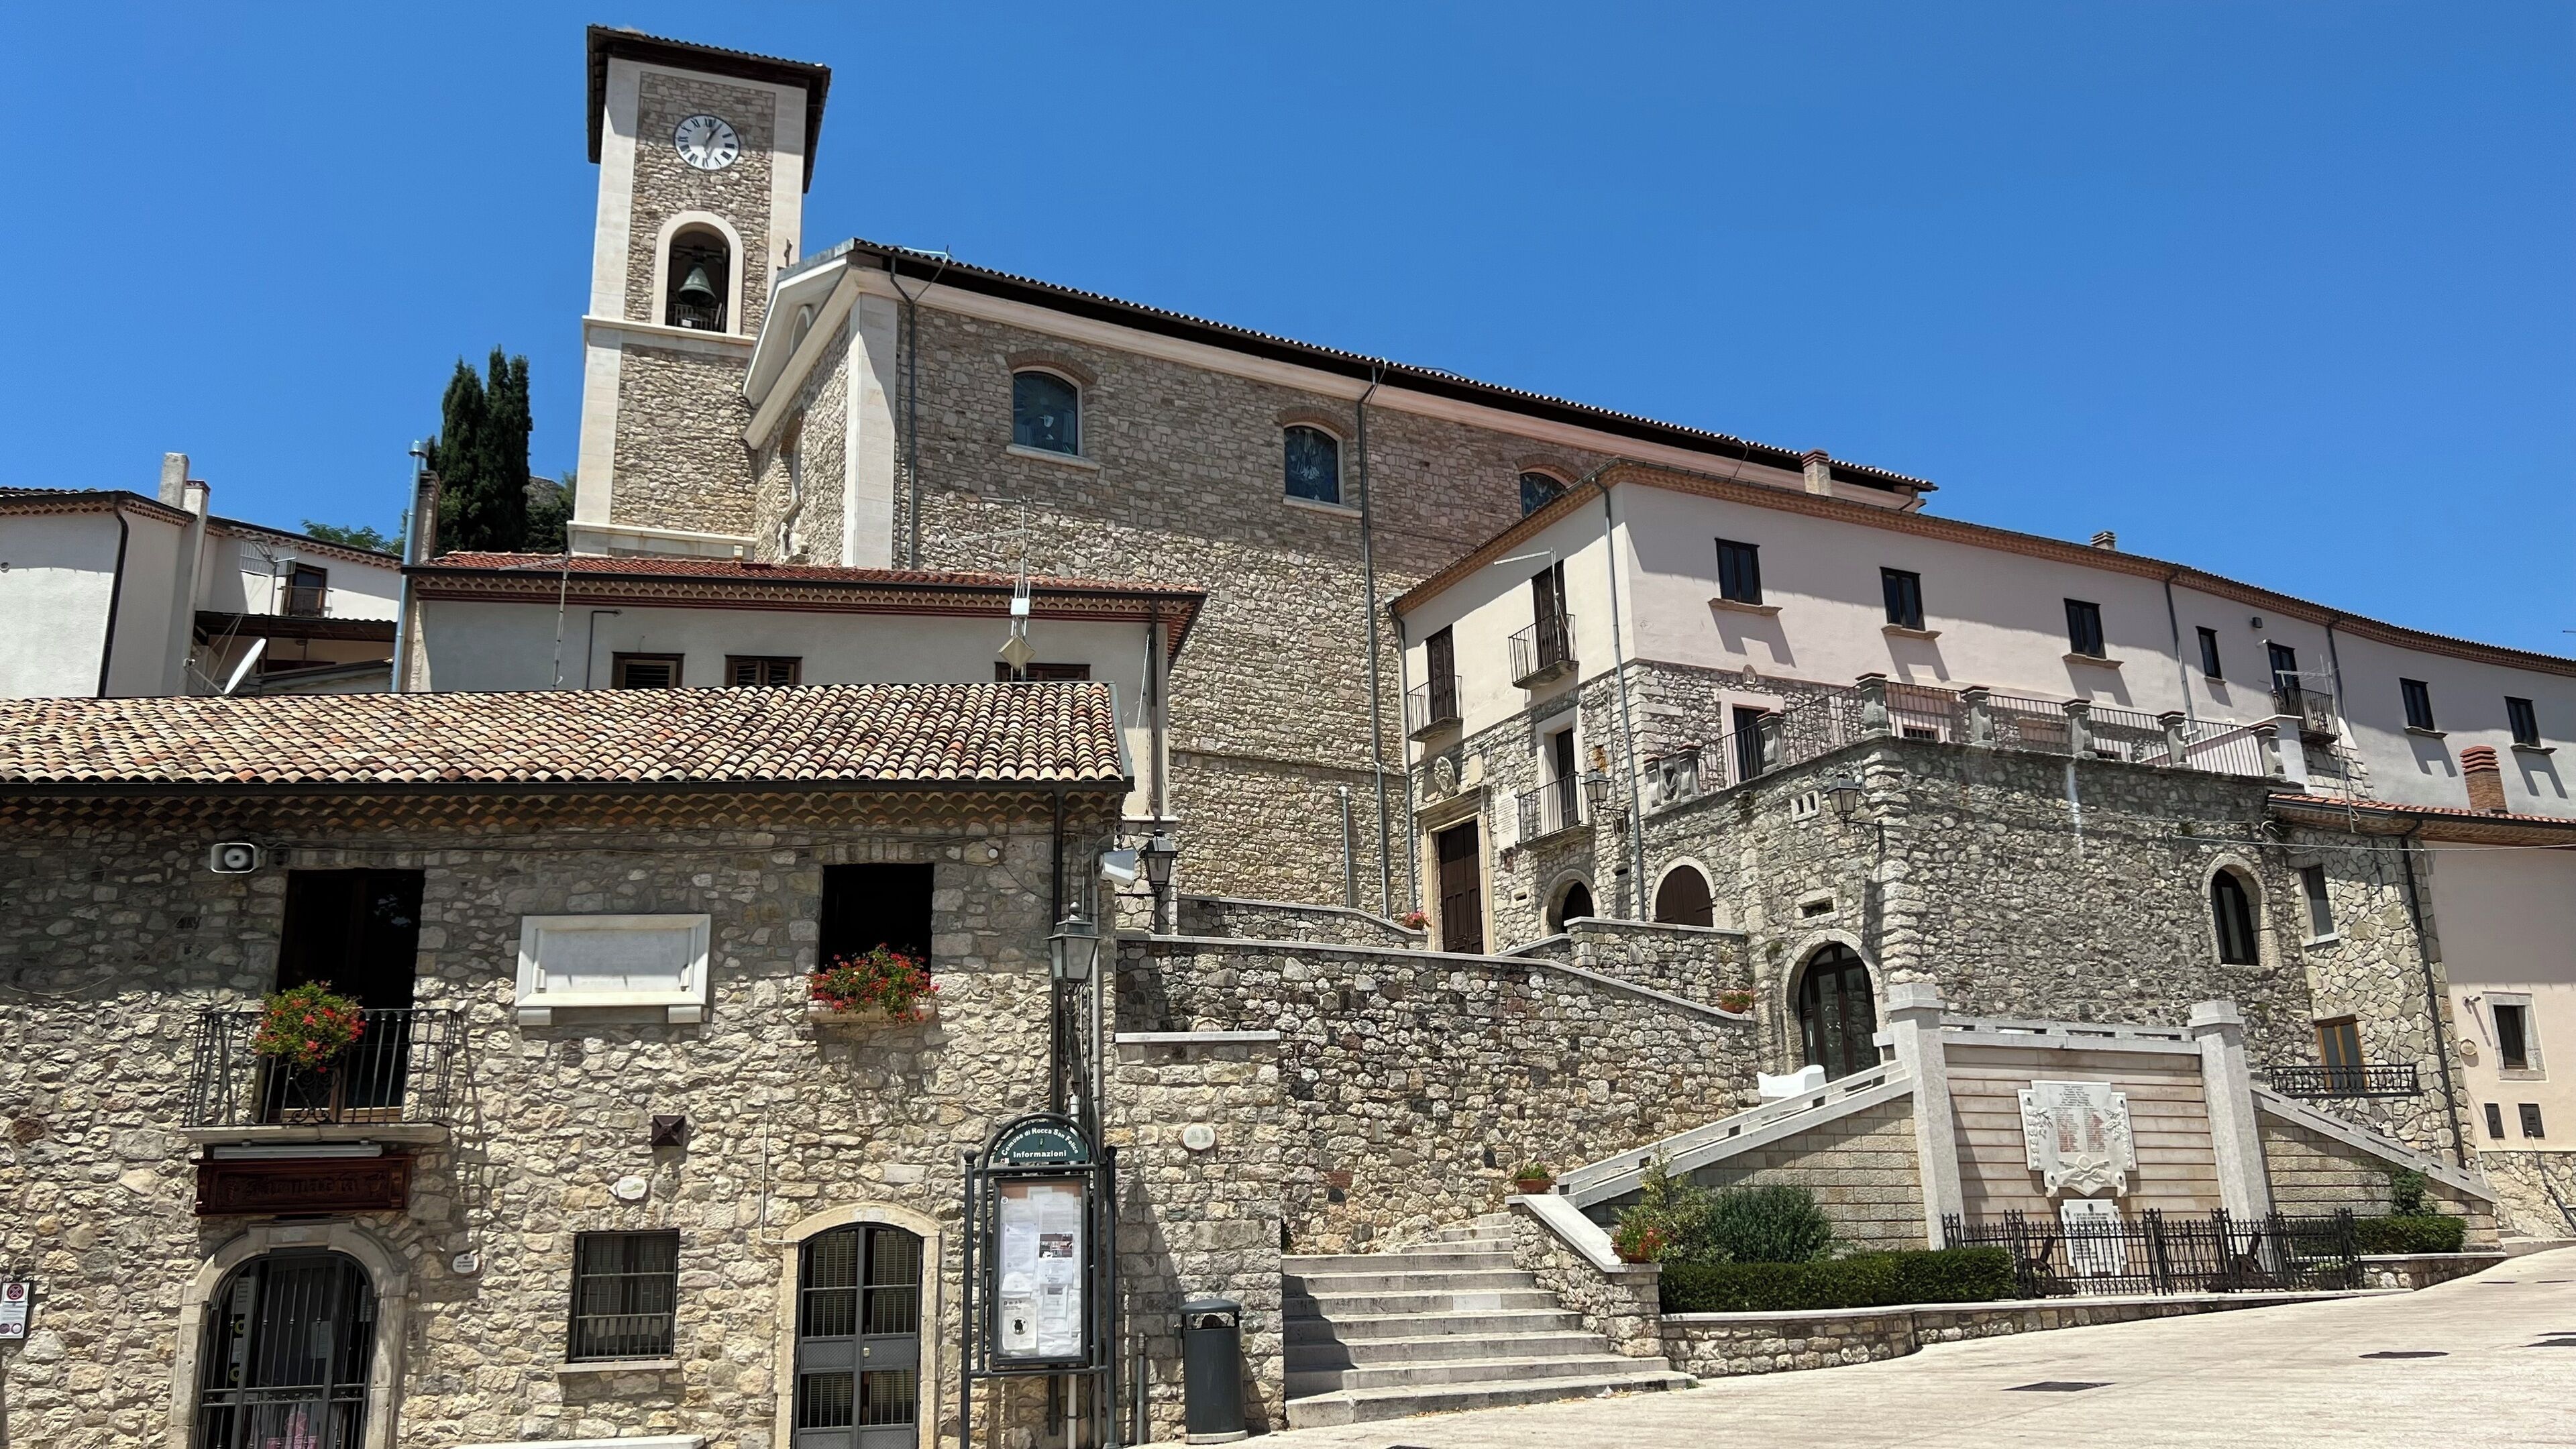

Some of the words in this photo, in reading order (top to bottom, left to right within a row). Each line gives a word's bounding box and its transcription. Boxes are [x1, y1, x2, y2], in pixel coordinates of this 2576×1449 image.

[1002, 1134, 1024, 1156] Comune
[1053, 1128, 1065, 1139] San
[1065, 1136, 1079, 1154] Felice
[1013, 1150, 1067, 1158] Informazioni
